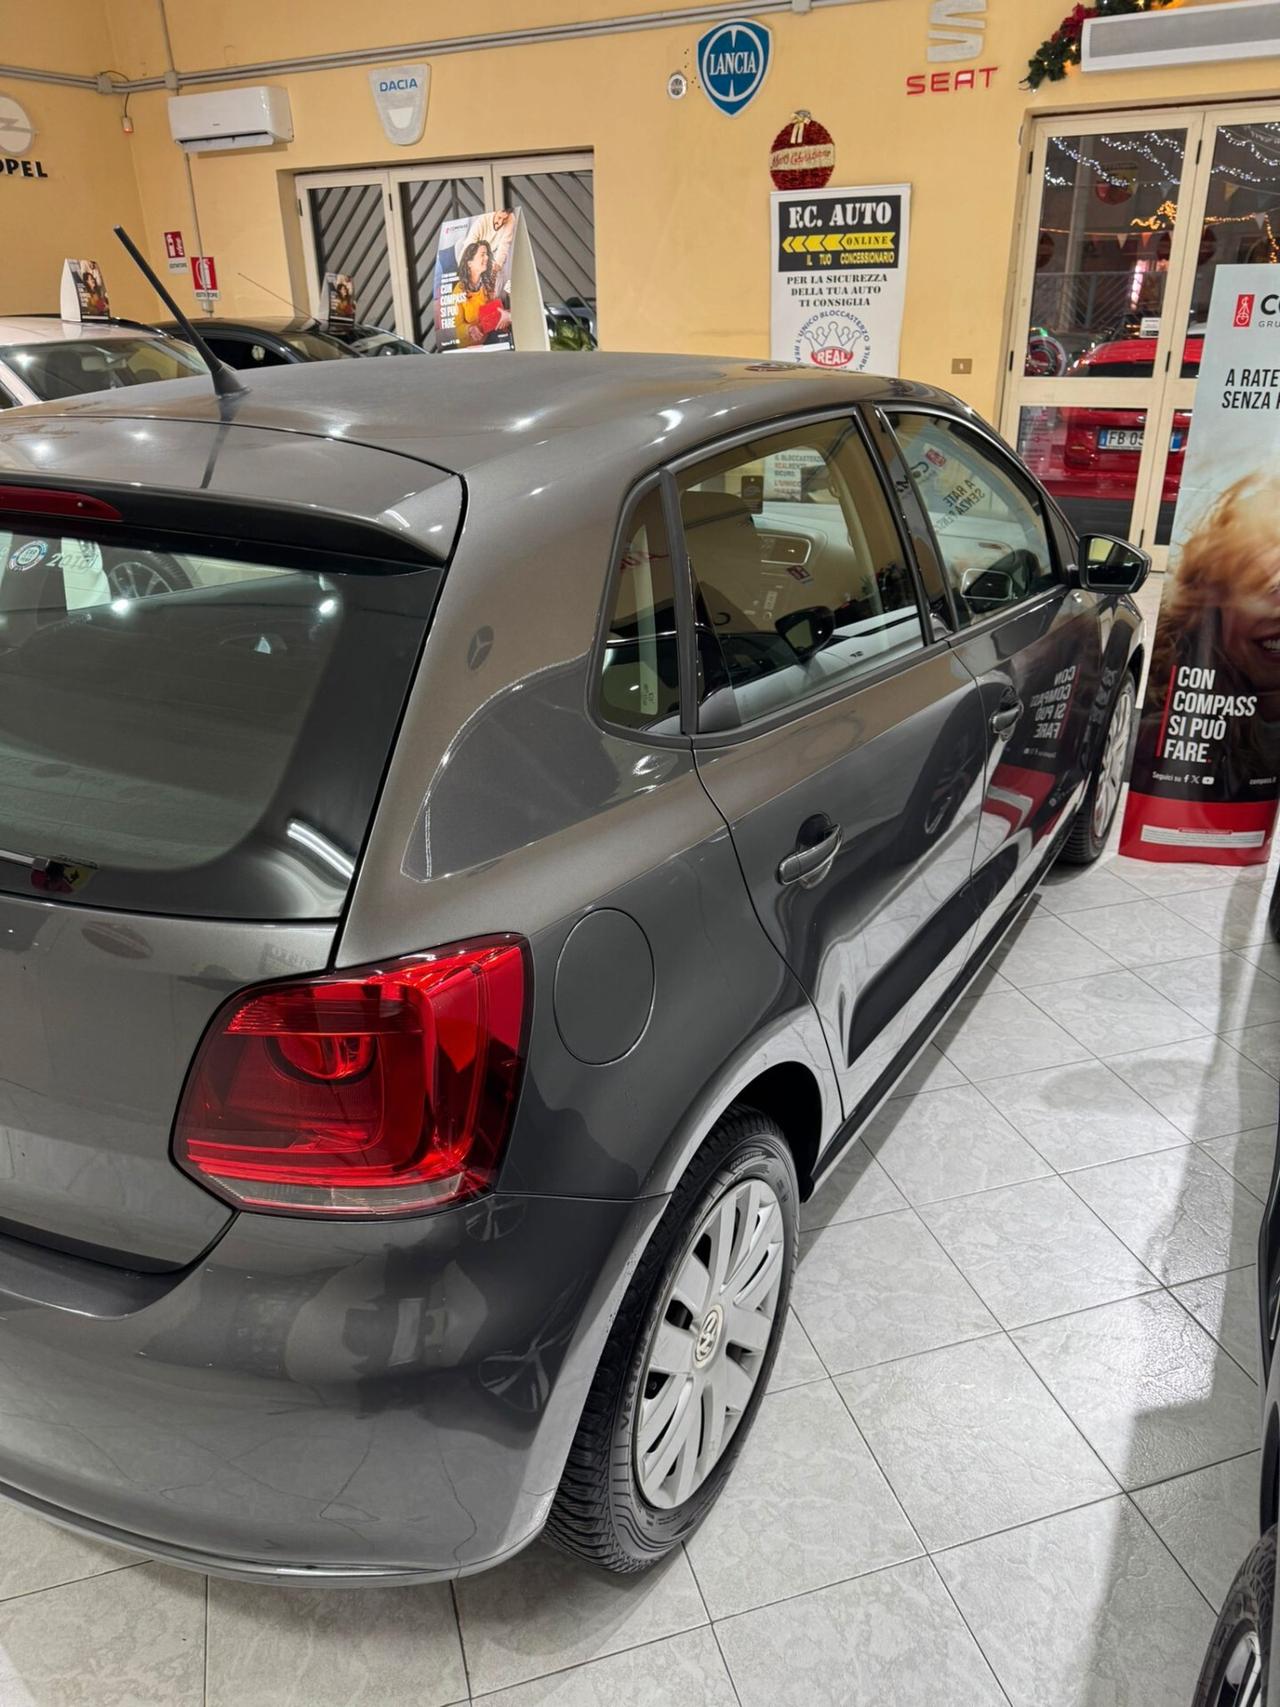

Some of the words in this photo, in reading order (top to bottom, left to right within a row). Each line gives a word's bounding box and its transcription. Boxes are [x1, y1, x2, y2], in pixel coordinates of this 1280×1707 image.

[709, 51, 757, 75] LANCIA
[379, 78, 418, 92] DACIA
[906, 67, 998, 95] SEAT
[0, 158, 49, 178] PEL
[788, 205, 823, 229] F.C.
[829, 201, 892, 227] AUTO
[846, 236, 889, 247] ONLINE
[806, 254, 813, 266] IL
[819, 253, 832, 265] TUO
[840, 251, 895, 264] CONCESSIONARIO
[787, 275, 808, 285] PER
[811, 274, 824, 284] LA
[826, 273, 888, 283] SICUREZZA
[791, 286, 824, 296] DELLA
[826, 286, 849, 295] TUA
[851, 286, 881, 295] AUTO
[799, 299, 810, 308] TI
[813, 297, 871, 307] CONSIGLIA
[1260, 294, 1280, 316] C
[820, 309, 870, 342] BLOCCASTERZO
[817, 348, 850, 364] REAL
[1225, 368, 1235, 387] A
[1240, 368, 1280, 388] RATE
[1222, 391, 1271, 410] SENZA
[1177, 666, 1216, 690] CON
[1172, 690, 1257, 717] COMPASS
[1168, 715, 1185, 736] SI
[1189, 714, 1227, 740] PUÒ
[1163, 739, 1212, 763] FARE.
